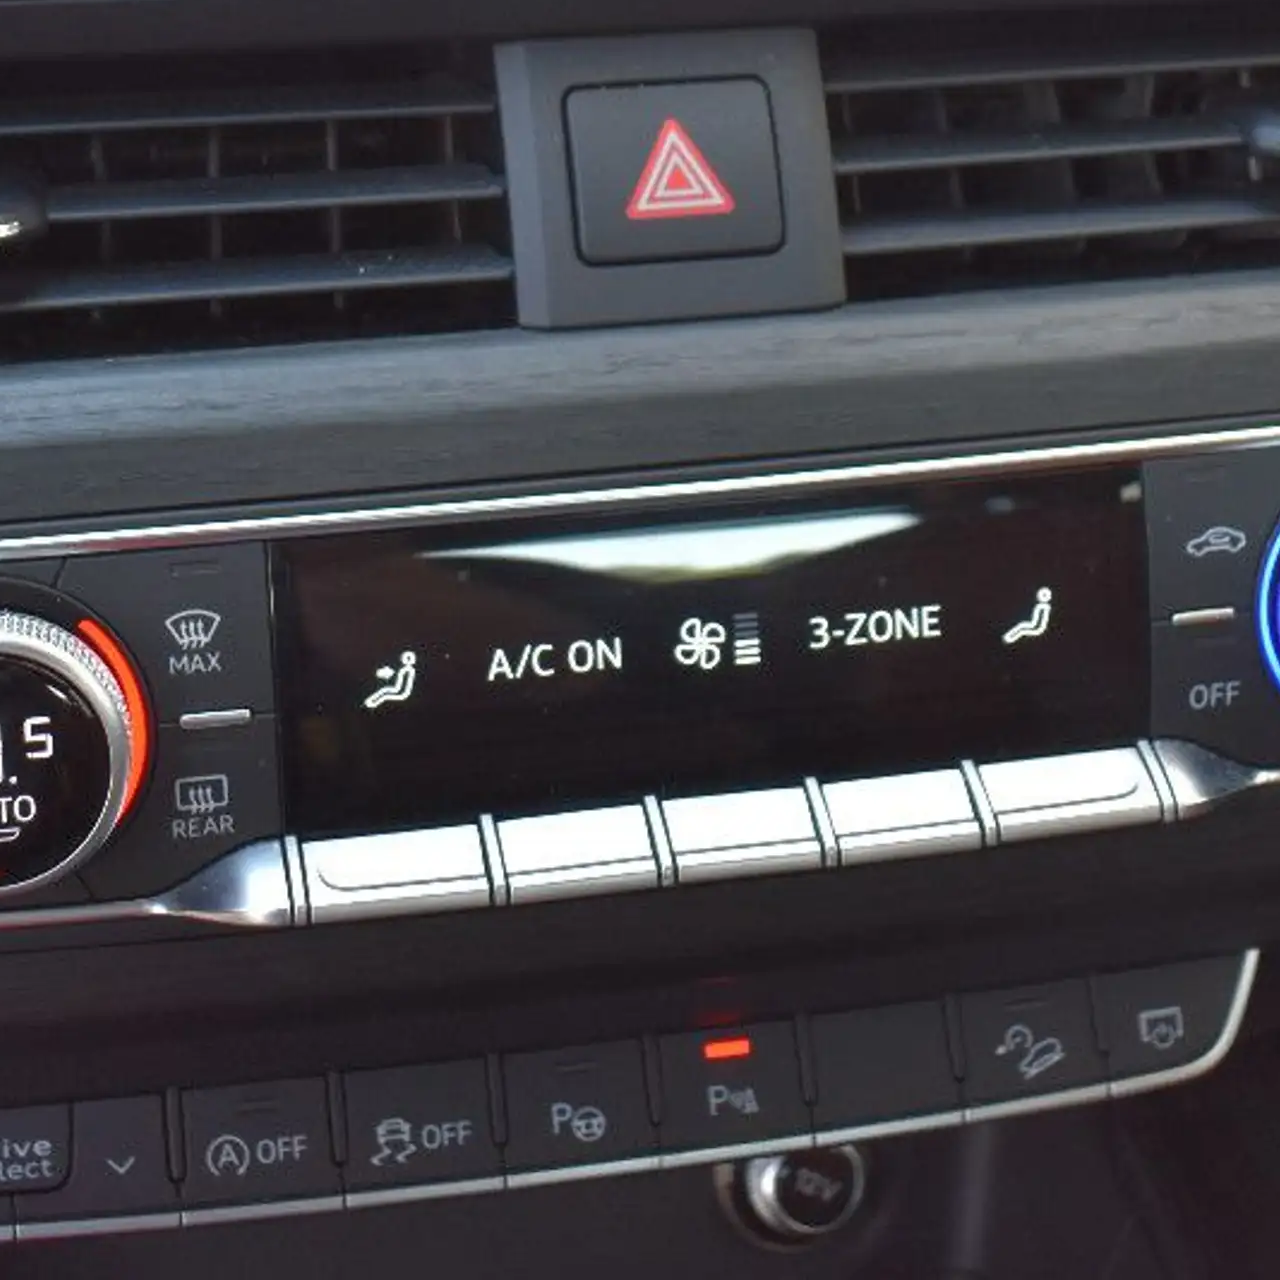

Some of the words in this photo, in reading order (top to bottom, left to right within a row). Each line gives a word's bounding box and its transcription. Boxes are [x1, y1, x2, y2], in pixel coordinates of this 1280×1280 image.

[809, 603, 942, 650] 3-ZONE
[169, 651, 222, 675] MAX
[487, 643, 556, 681] A/C
[566, 637, 623, 674] ON
[1188, 680, 1242, 710] OFF
[172, 814, 236, 839] REAR
[256, 1134, 308, 1164] OFF
[422, 1120, 473, 1150] OFF
